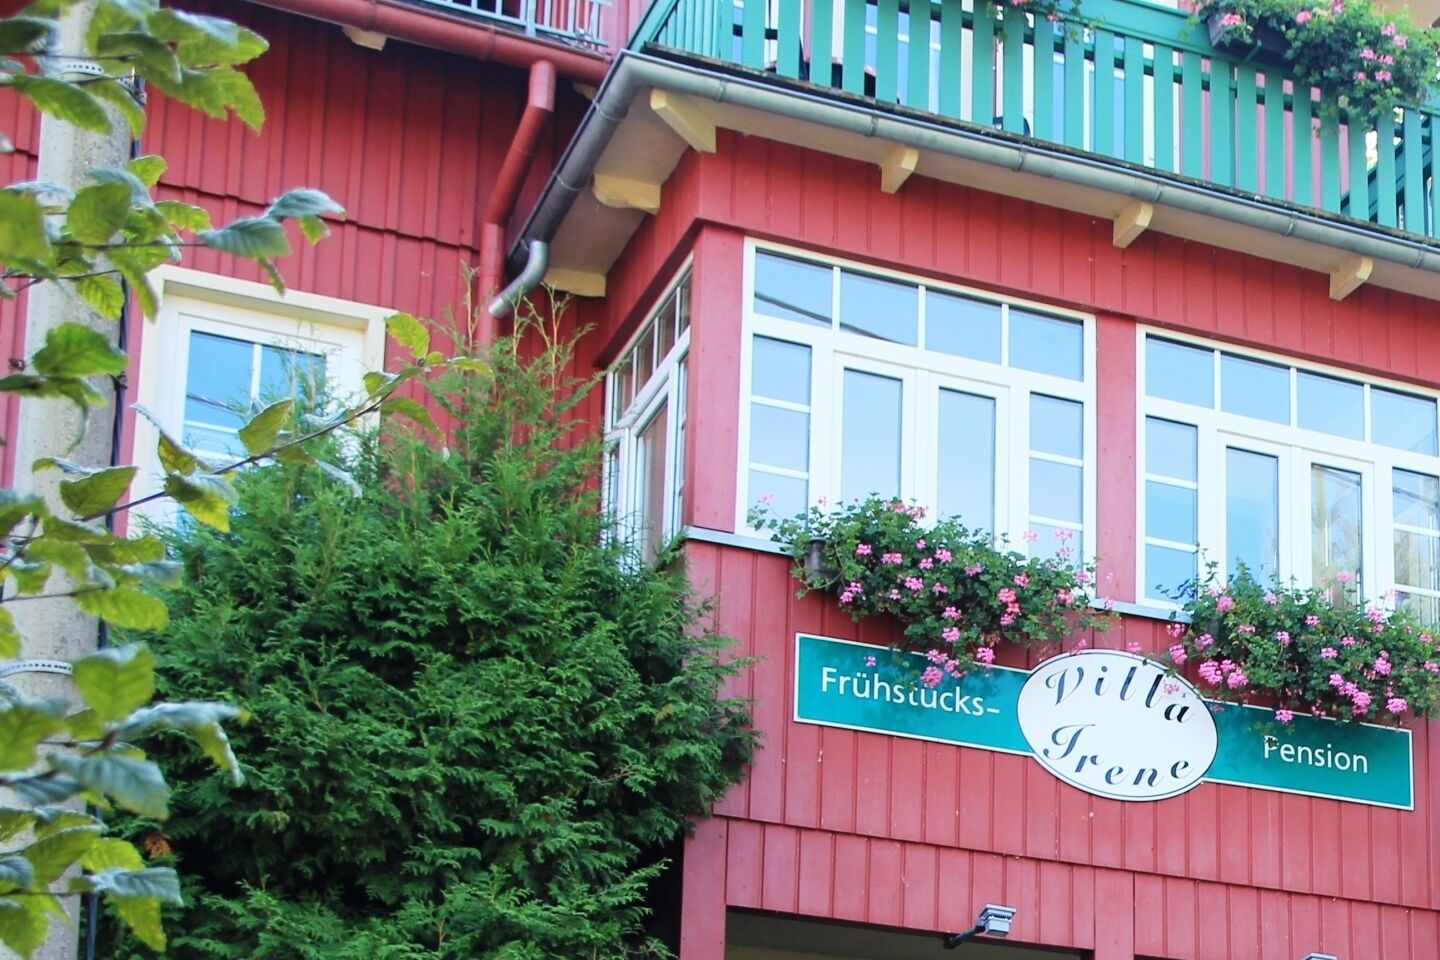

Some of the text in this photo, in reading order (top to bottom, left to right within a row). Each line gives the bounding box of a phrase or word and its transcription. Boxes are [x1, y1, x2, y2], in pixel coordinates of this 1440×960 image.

[1045, 665, 1194, 723] Villa
[1043, 723, 1194, 787] Irene
[1263, 734, 1368, 773] Pension
